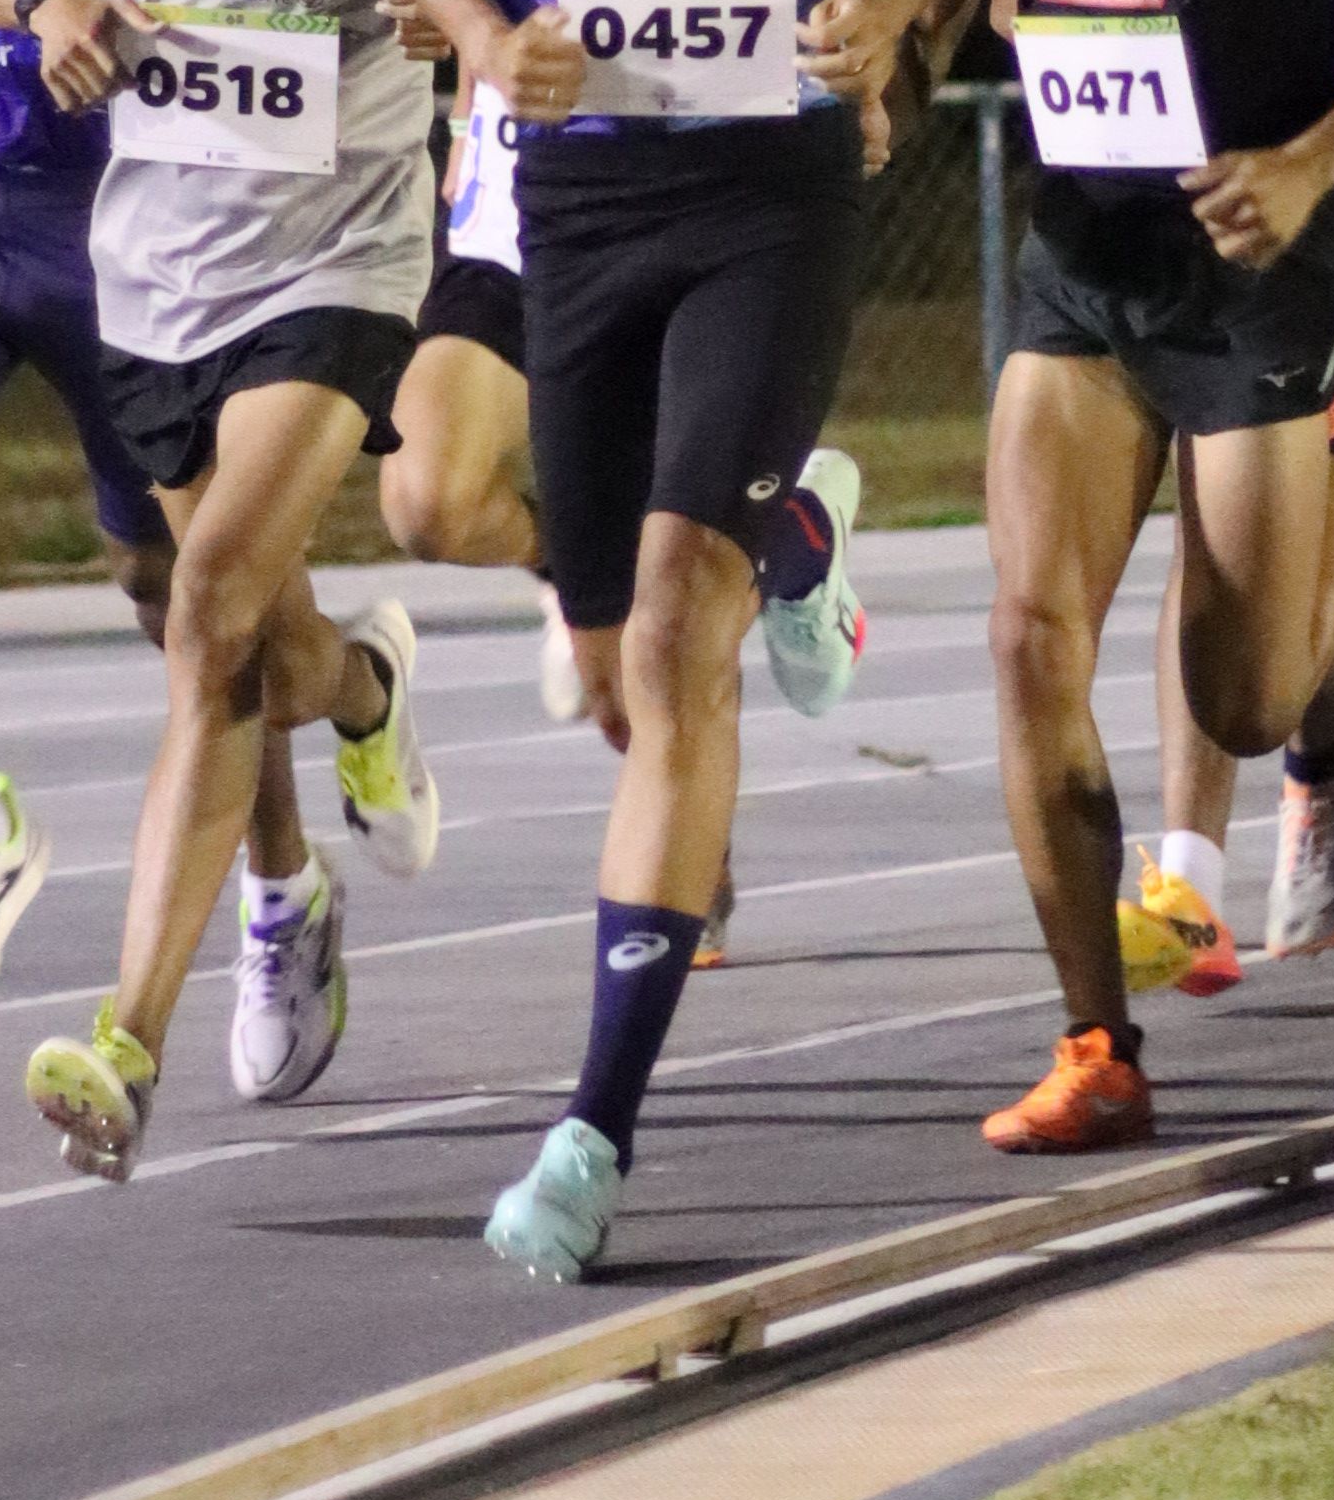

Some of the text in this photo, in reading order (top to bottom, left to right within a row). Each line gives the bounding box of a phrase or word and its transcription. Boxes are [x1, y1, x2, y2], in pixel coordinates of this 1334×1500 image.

[581, 6, 771, 60] 0457
[136, 56, 304, 118] 0518
[1040, 70, 1168, 115] 0471
